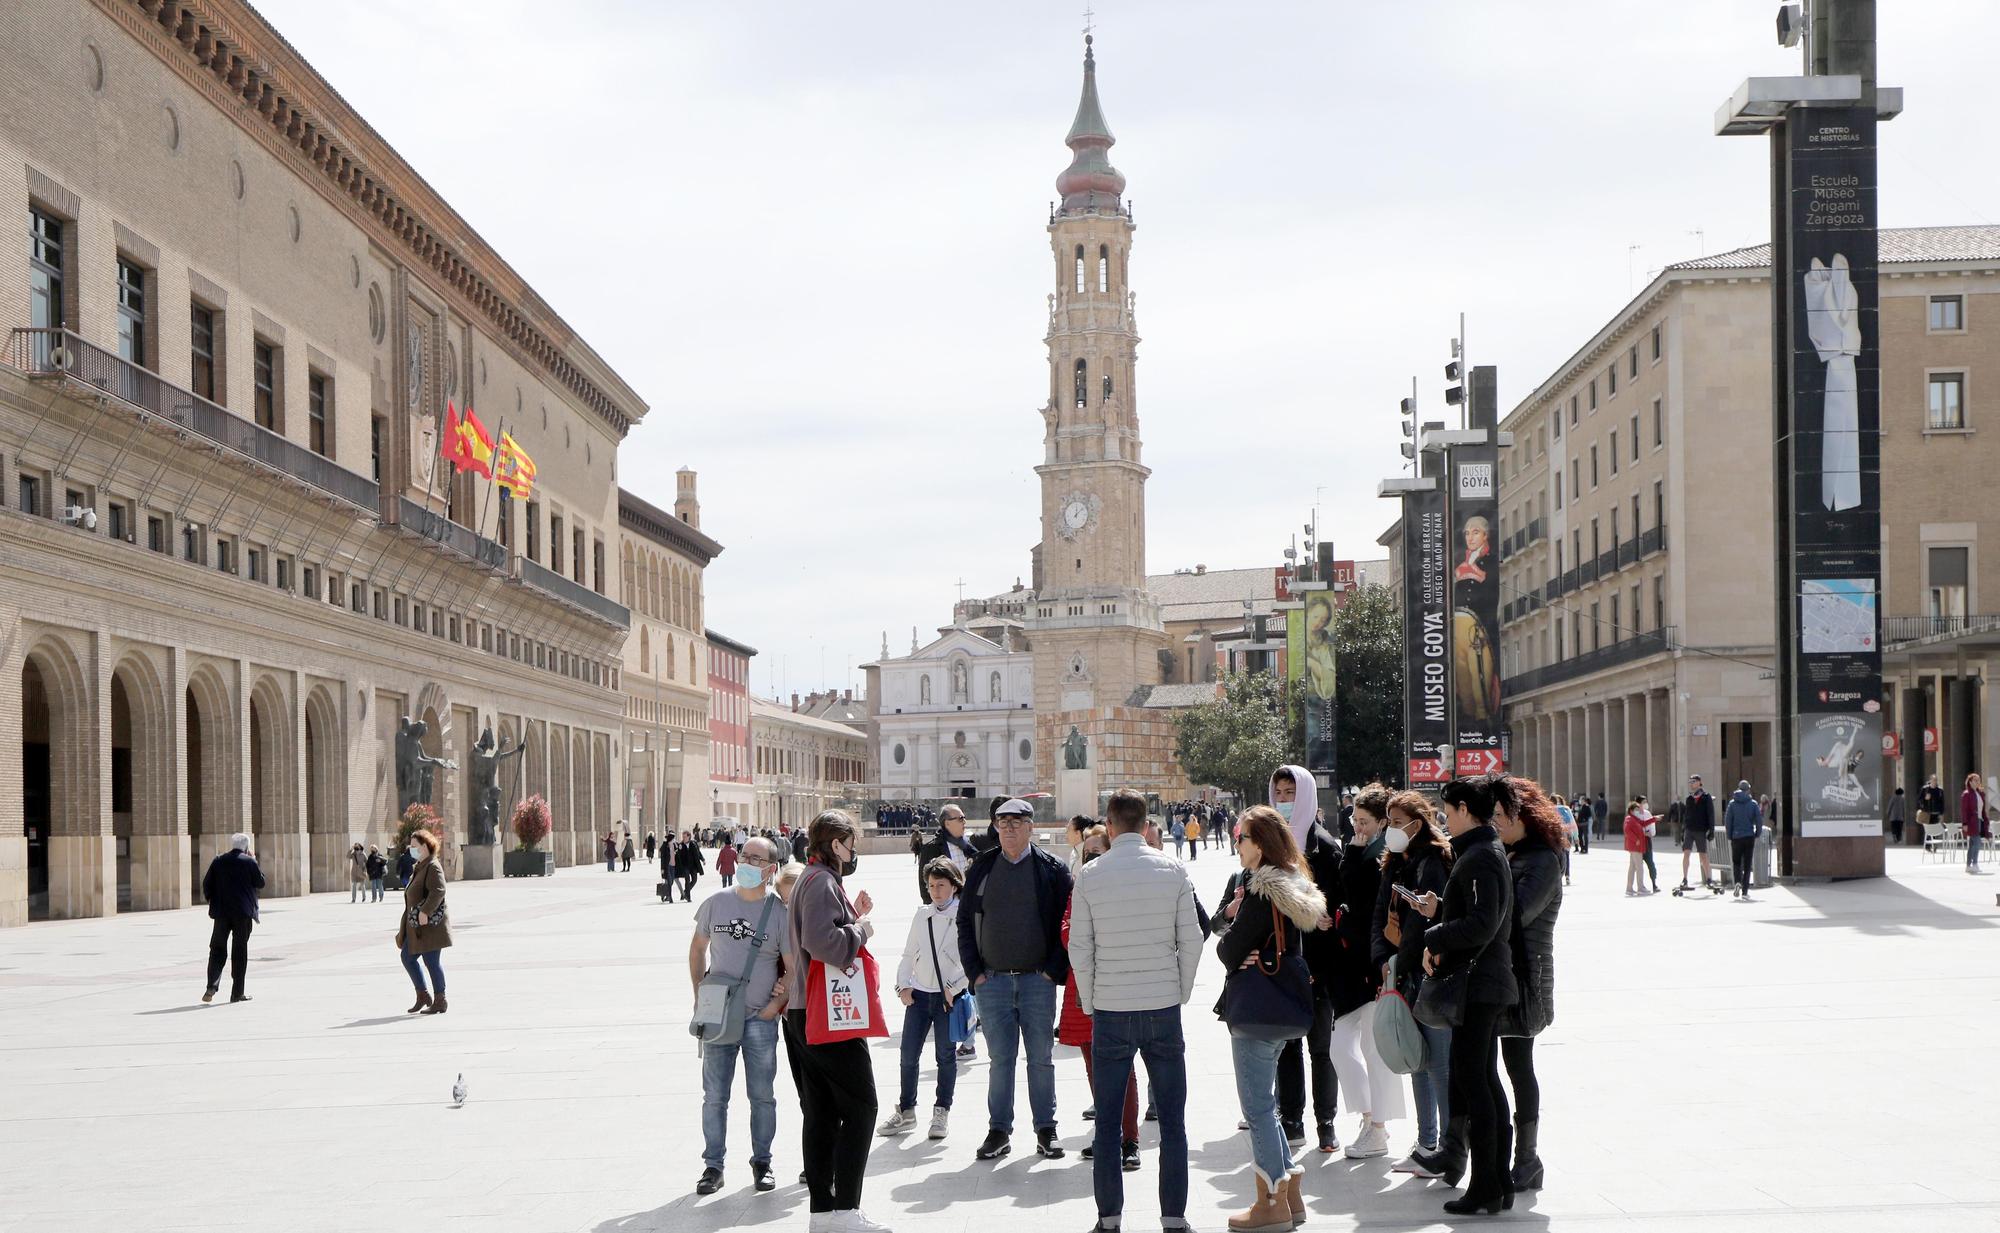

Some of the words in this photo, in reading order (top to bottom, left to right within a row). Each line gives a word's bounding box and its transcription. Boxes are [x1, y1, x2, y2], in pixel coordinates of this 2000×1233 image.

[1820, 134, 1860, 142] HISTORIAS
[1811, 174, 1858, 186] Escuela
[1814, 188, 1855, 199] Museo
[1809, 200, 1860, 214] Origami
[1806, 213, 1865, 226] Zaragoza
[1462, 465, 1489, 477] MUSEO
[1462, 477, 1489, 488] GOYA
[1434, 512, 1442, 538] AZNAR
[1422, 512, 1431, 552] IBERCAJA
[1433, 543, 1443, 571] CAMÓN
[1422, 557, 1432, 604] COLECCIÓN
[1435, 575, 1443, 604] MUSEO
[1423, 611, 1444, 657] GOYA
[1424, 663, 1445, 721] MUSEO
[1829, 691, 1862, 701] Zaragoza
[1467, 752, 1481, 762] 75
[1419, 762, 1431, 770] 75
[832, 993, 852, 1007] GÜ
